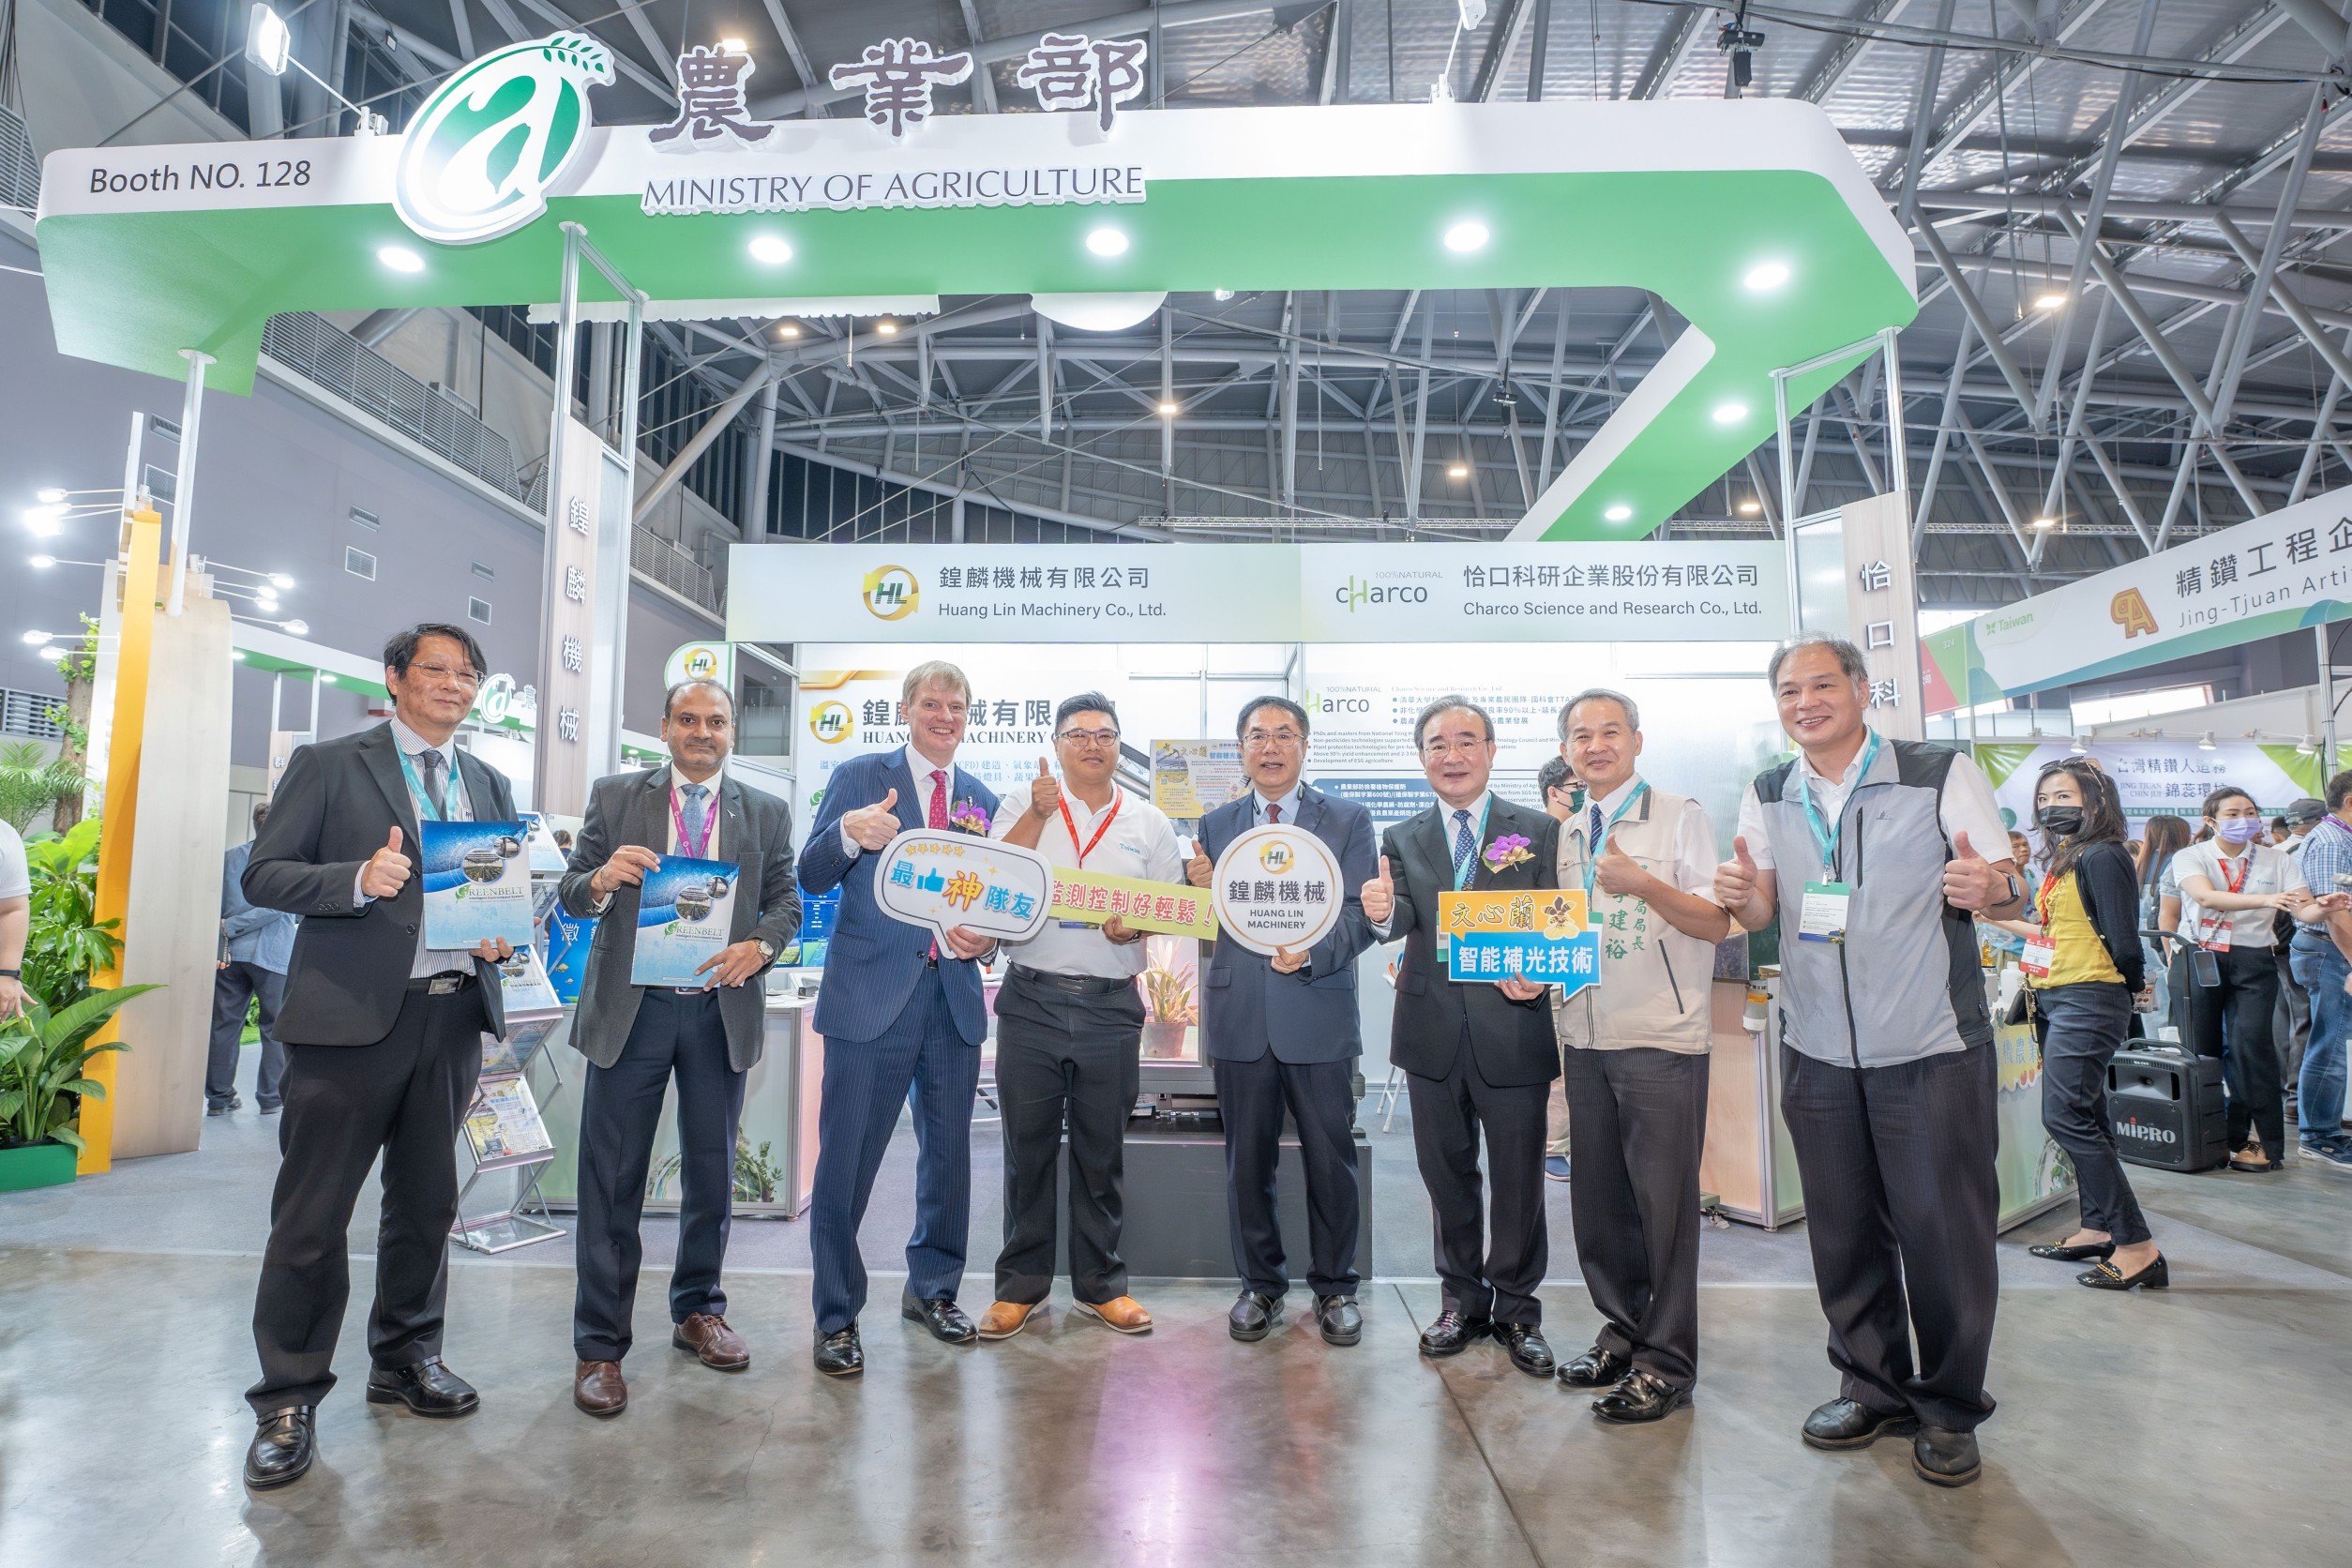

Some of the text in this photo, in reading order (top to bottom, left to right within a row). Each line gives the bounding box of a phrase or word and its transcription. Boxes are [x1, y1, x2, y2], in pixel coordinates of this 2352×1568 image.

[648, 35, 1143, 142] 農業部
[90, 160, 311, 193] Booth NO. 128
[644, 167, 1144, 206] MINISTRY OF AGRICULTURE
[2176, 517, 2352, 598] 精鑽工程企
[939, 566, 1151, 590] 鍠麟機械有限公司
[1375, 570, 1443, 579] 100%NATURAL
[1463, 564, 1758, 587] 恰口科研企業股份有限公司
[1463, 601, 1762, 616] Charco Science and Research Co., Ltd.
[2179, 565, 2352, 627] Jing-Tjuan Arti
[559, 496, 590, 742] 鍠麟機械
[939, 603, 1167, 620] Huang Lin Machinery Co., Ltd.
[1998, 613, 2034, 632] Taiwan
[1861, 560, 1901, 710] 恰口科
[1267, 852, 1288, 865] HL
[1229, 880, 1326, 902] 鍠麟機械
[1247, 921, 1306, 929] MACHINERY
[1451, 895, 1535, 930] 文心蘭
[1458, 945, 1593, 974] 智能補光技術
